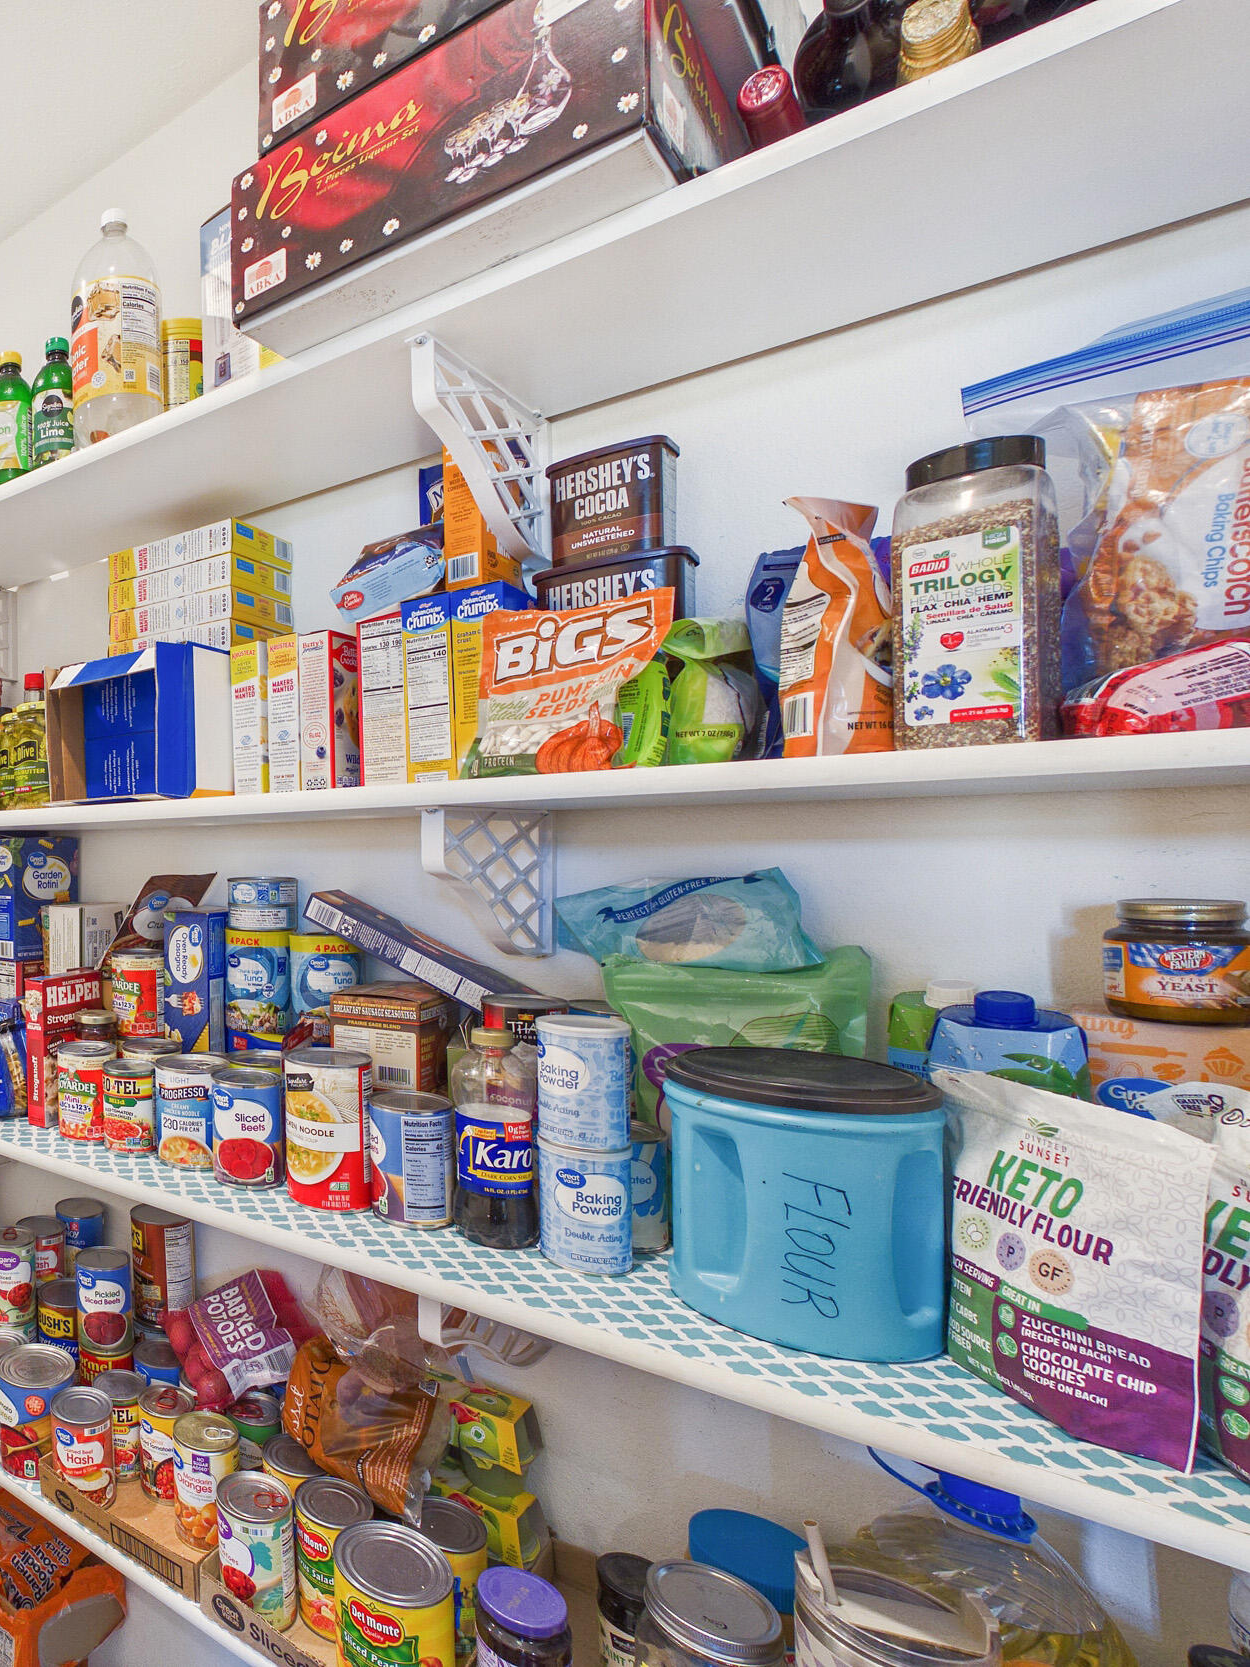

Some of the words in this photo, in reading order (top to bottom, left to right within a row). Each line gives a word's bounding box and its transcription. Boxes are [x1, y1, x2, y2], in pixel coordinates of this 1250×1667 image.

[274, 94, 313, 127] ABKA
[316, 178, 324, 190] 7
[324, 164, 356, 186] Pieces
[358, 138, 399, 166] Liqueur
[400, 124, 420, 140] Set
[122, 302, 144, 310] Calories
[51, 420, 69, 428] Juice
[41, 428, 64, 437] Lime
[554, 454, 650, 503] HERSHEY'S
[574, 487, 630, 520] COCOA
[581, 518, 597, 526] 100%
[598, 512, 622, 521] CACAO
[1204, 492, 1235, 543] Baking
[571, 529, 635, 550] UNSWEETENED
[582, 525, 622, 539] NATURAL
[910, 560, 947, 575] BADIA
[955, 553, 1012, 572] WHOLE
[1201, 545, 1226, 588] Chips
[909, 565, 1013, 596] TRILOGY
[548, 569, 655, 610] HERSHEY'S
[764, 586, 775, 600] 2
[910, 589, 961, 606] HEALTH
[965, 582, 1013, 597] SEEDS
[457, 599, 499, 618] Crumbs
[910, 602, 937, 614] FLAX
[944, 597, 971, 608] CHIA
[978, 591, 1013, 603] HEMP
[926, 609, 966, 620] Semillas
[969, 606, 981, 614] de
[984, 601, 1013, 610] Salud
[362, 620, 385, 629] Nutrition
[406, 611, 445, 631] Crumbs
[407, 637, 429, 645] Nutrition
[407, 654, 430, 662] Calories
[432, 650, 447, 658] 140
[235, 685, 255, 694] MAKERS
[272, 679, 294, 688] MAKERS
[535, 663, 635, 706] PUMPKIN
[525, 698, 588, 720] SEEDS
[847, 722, 864, 730] NET
[484, 756, 515, 767] PROTEIN
[33, 871, 62, 880] Garden
[37, 880, 58, 890] Rotini
[615, 903, 650, 922] PERFECT
[657, 877, 708, 907] GLUTEN-FREE
[236, 938, 260, 946] PACK
[315, 944, 322, 952] 4
[324, 945, 350, 953] PACK
[1164, 950, 1206, 962] WESTERN
[1170, 959, 1200, 970] FAMILY
[243, 975, 263, 983] Tuna
[333, 977, 353, 985] Tuna
[1157, 980, 1219, 993] YEAST
[46, 980, 100, 1008] HELPER
[333, 1005, 361, 1016] BREAKFAST
[361, 1007, 384, 1017] SAUSAGE
[384, 1009, 417, 1020] SEASONINGS
[348, 1019, 367, 1027] PRAIRIE
[541, 1062, 579, 1080] Baking
[539, 1072, 579, 1090] Powder
[64, 1094, 80, 1103] Mini
[161, 1086, 206, 1100] PROGRESSO
[181, 1109, 200, 1117] NOODLE
[235, 1112, 265, 1123] Sliced
[163, 1117, 178, 1130] 230
[179, 1120, 203, 1128] CALORIES
[241, 1123, 266, 1132] Beets
[300, 1125, 335, 1138] NOODLE
[475, 1141, 531, 1169] Karo
[1018, 1140, 1070, 1168] SUNSET
[558, 1170, 580, 1180] Great
[986, 1150, 1084, 1218] KETO
[576, 1192, 622, 1207] Baking
[572, 1202, 622, 1216] Powder
[952, 1175, 1033, 1229] FRIENDLY
[1031, 1213, 1114, 1266] FLOUR
[564, 1227, 596, 1242] Double
[597, 1232, 623, 1243] Acting
[780, 1172, 852, 1319] FLOUR
[964, 1262, 995, 1287] SERVING
[94, 1290, 120, 1298] Pickled
[1001, 1285, 1025, 1307] GREAT
[1027, 1300, 1041, 1314] IN
[1021, 1326, 1059, 1348] (RECIPE
[1021, 1315, 1093, 1349] ZUCCHINI
[1096, 1340, 1151, 1368] BREAD
[1021, 1342, 1114, 1383] CHOCOLATE
[1116, 1373, 1157, 1395] CHIP
[1022, 1354, 1086, 1387] COOKIES
[66, 1452, 94, 1465] Hash
[177, 1474, 213, 1494] Oranges
[182, 1472, 212, 1485] Mandarin
[304, 1532, 328, 1554] Monte
[10, 1555, 45, 1602] Ramen
[312, 1569, 334, 1585] Salad
[351, 1605, 366, 1625] Del
[368, 1618, 400, 1638] Monte
[344, 1630, 367, 1657] Sliced
